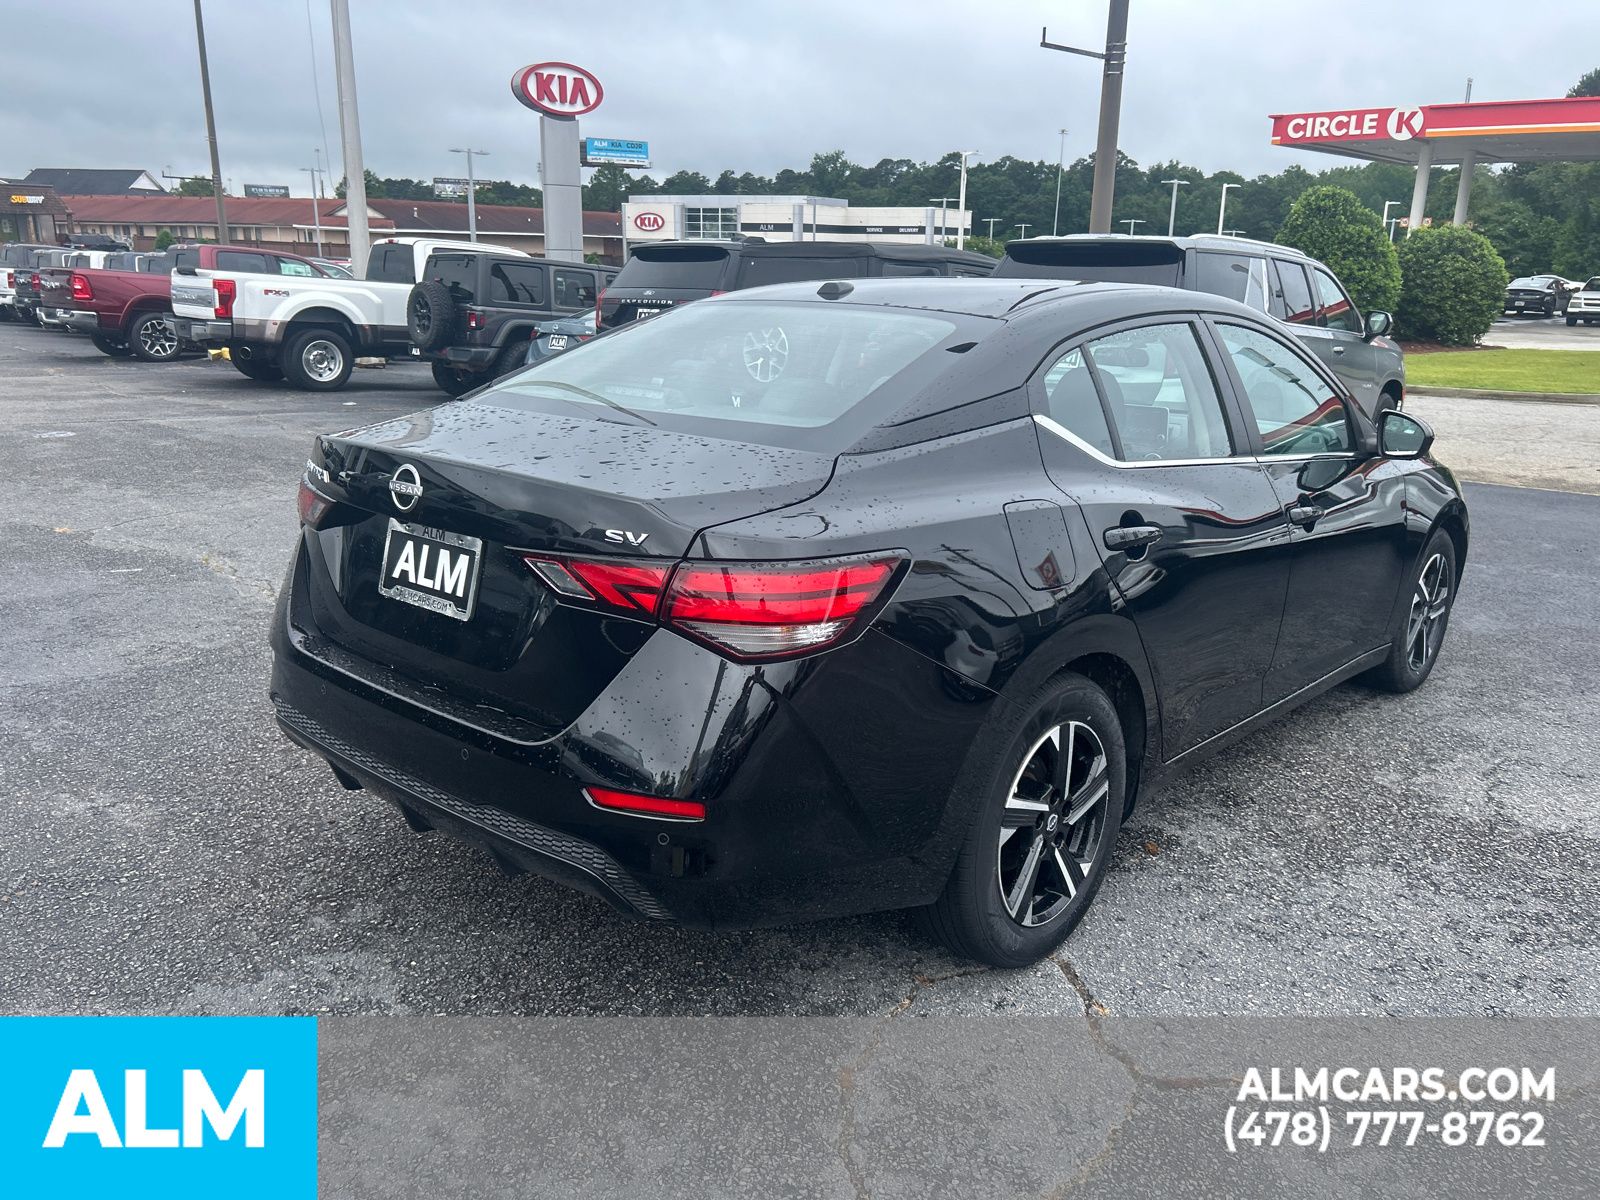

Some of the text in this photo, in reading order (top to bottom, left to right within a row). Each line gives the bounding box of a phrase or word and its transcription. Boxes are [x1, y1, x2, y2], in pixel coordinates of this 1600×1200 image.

[535, 72, 591, 107] KIA
[1287, 110, 1419, 139] CIRCLE K
[640, 216, 660, 228] KIA
[759, 223, 774, 231] ALM
[263, 289, 290, 297] FX4
[551, 338, 566, 346] ALM
[389, 481, 423, 496] NISSAN
[422, 527, 446, 542] ALM
[604, 529, 649, 546] SV
[392, 540, 470, 598] ALM
